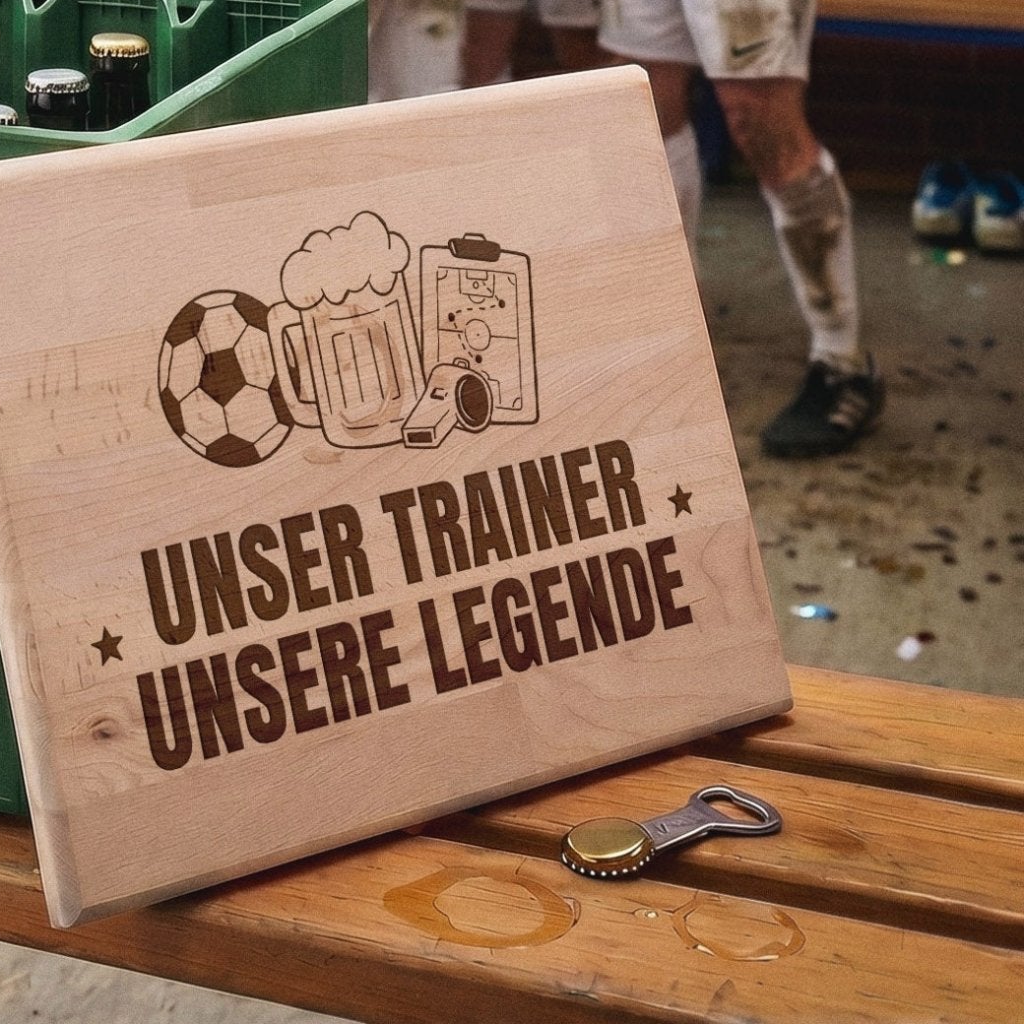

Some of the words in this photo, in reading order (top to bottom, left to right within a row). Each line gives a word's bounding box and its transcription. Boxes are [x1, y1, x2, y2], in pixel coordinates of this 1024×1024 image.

[135, 609, 412, 772] UNSERE
[418, 535, 694, 696] LEGENDE
[140, 503, 375, 646] UNSER
[379, 439, 647, 584] TRAINER
